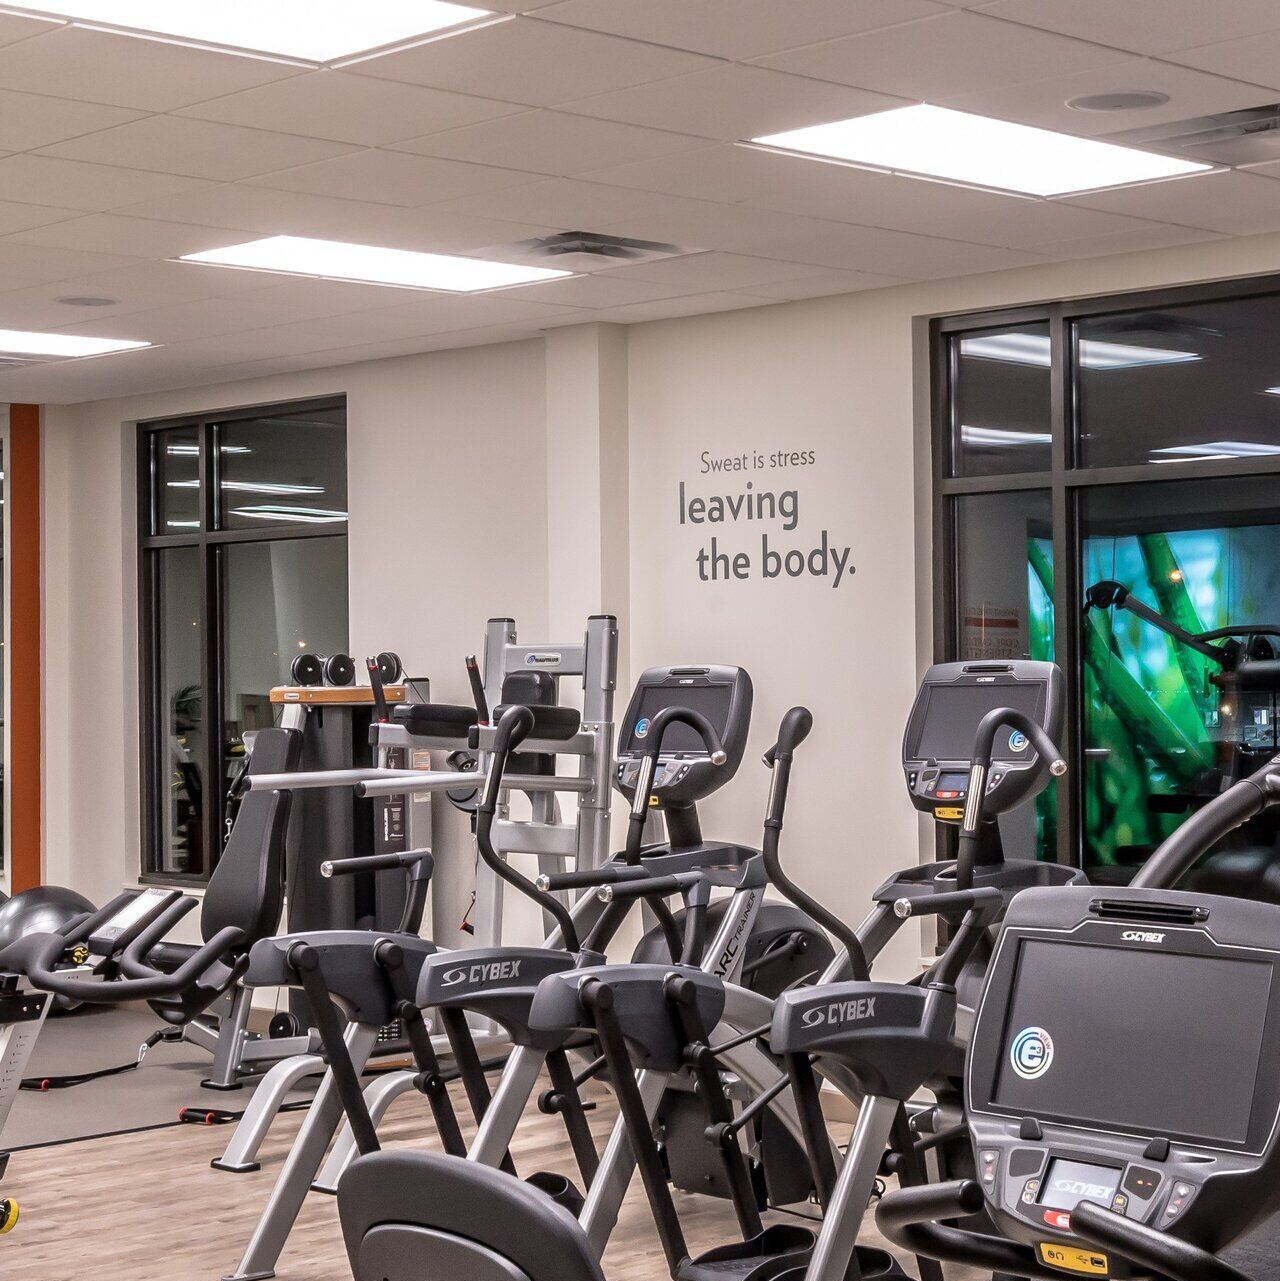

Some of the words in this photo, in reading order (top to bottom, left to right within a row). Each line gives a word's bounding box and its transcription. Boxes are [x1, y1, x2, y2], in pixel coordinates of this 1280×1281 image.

[700, 451, 748, 473] Sweat
[753, 450, 764, 469] is
[770, 450, 815, 468] stress
[679, 481, 799, 531] leaving
[696, 536, 750, 581] the
[762, 530, 856, 588] body.
[733, 891, 756, 941] TRAINER
[1134, 931, 1166, 943] CYBEX
[469, 960, 522, 984] CYBEX
[827, 997, 877, 1024] CYBEX
[1070, 1181, 1115, 1199] CYBEX
